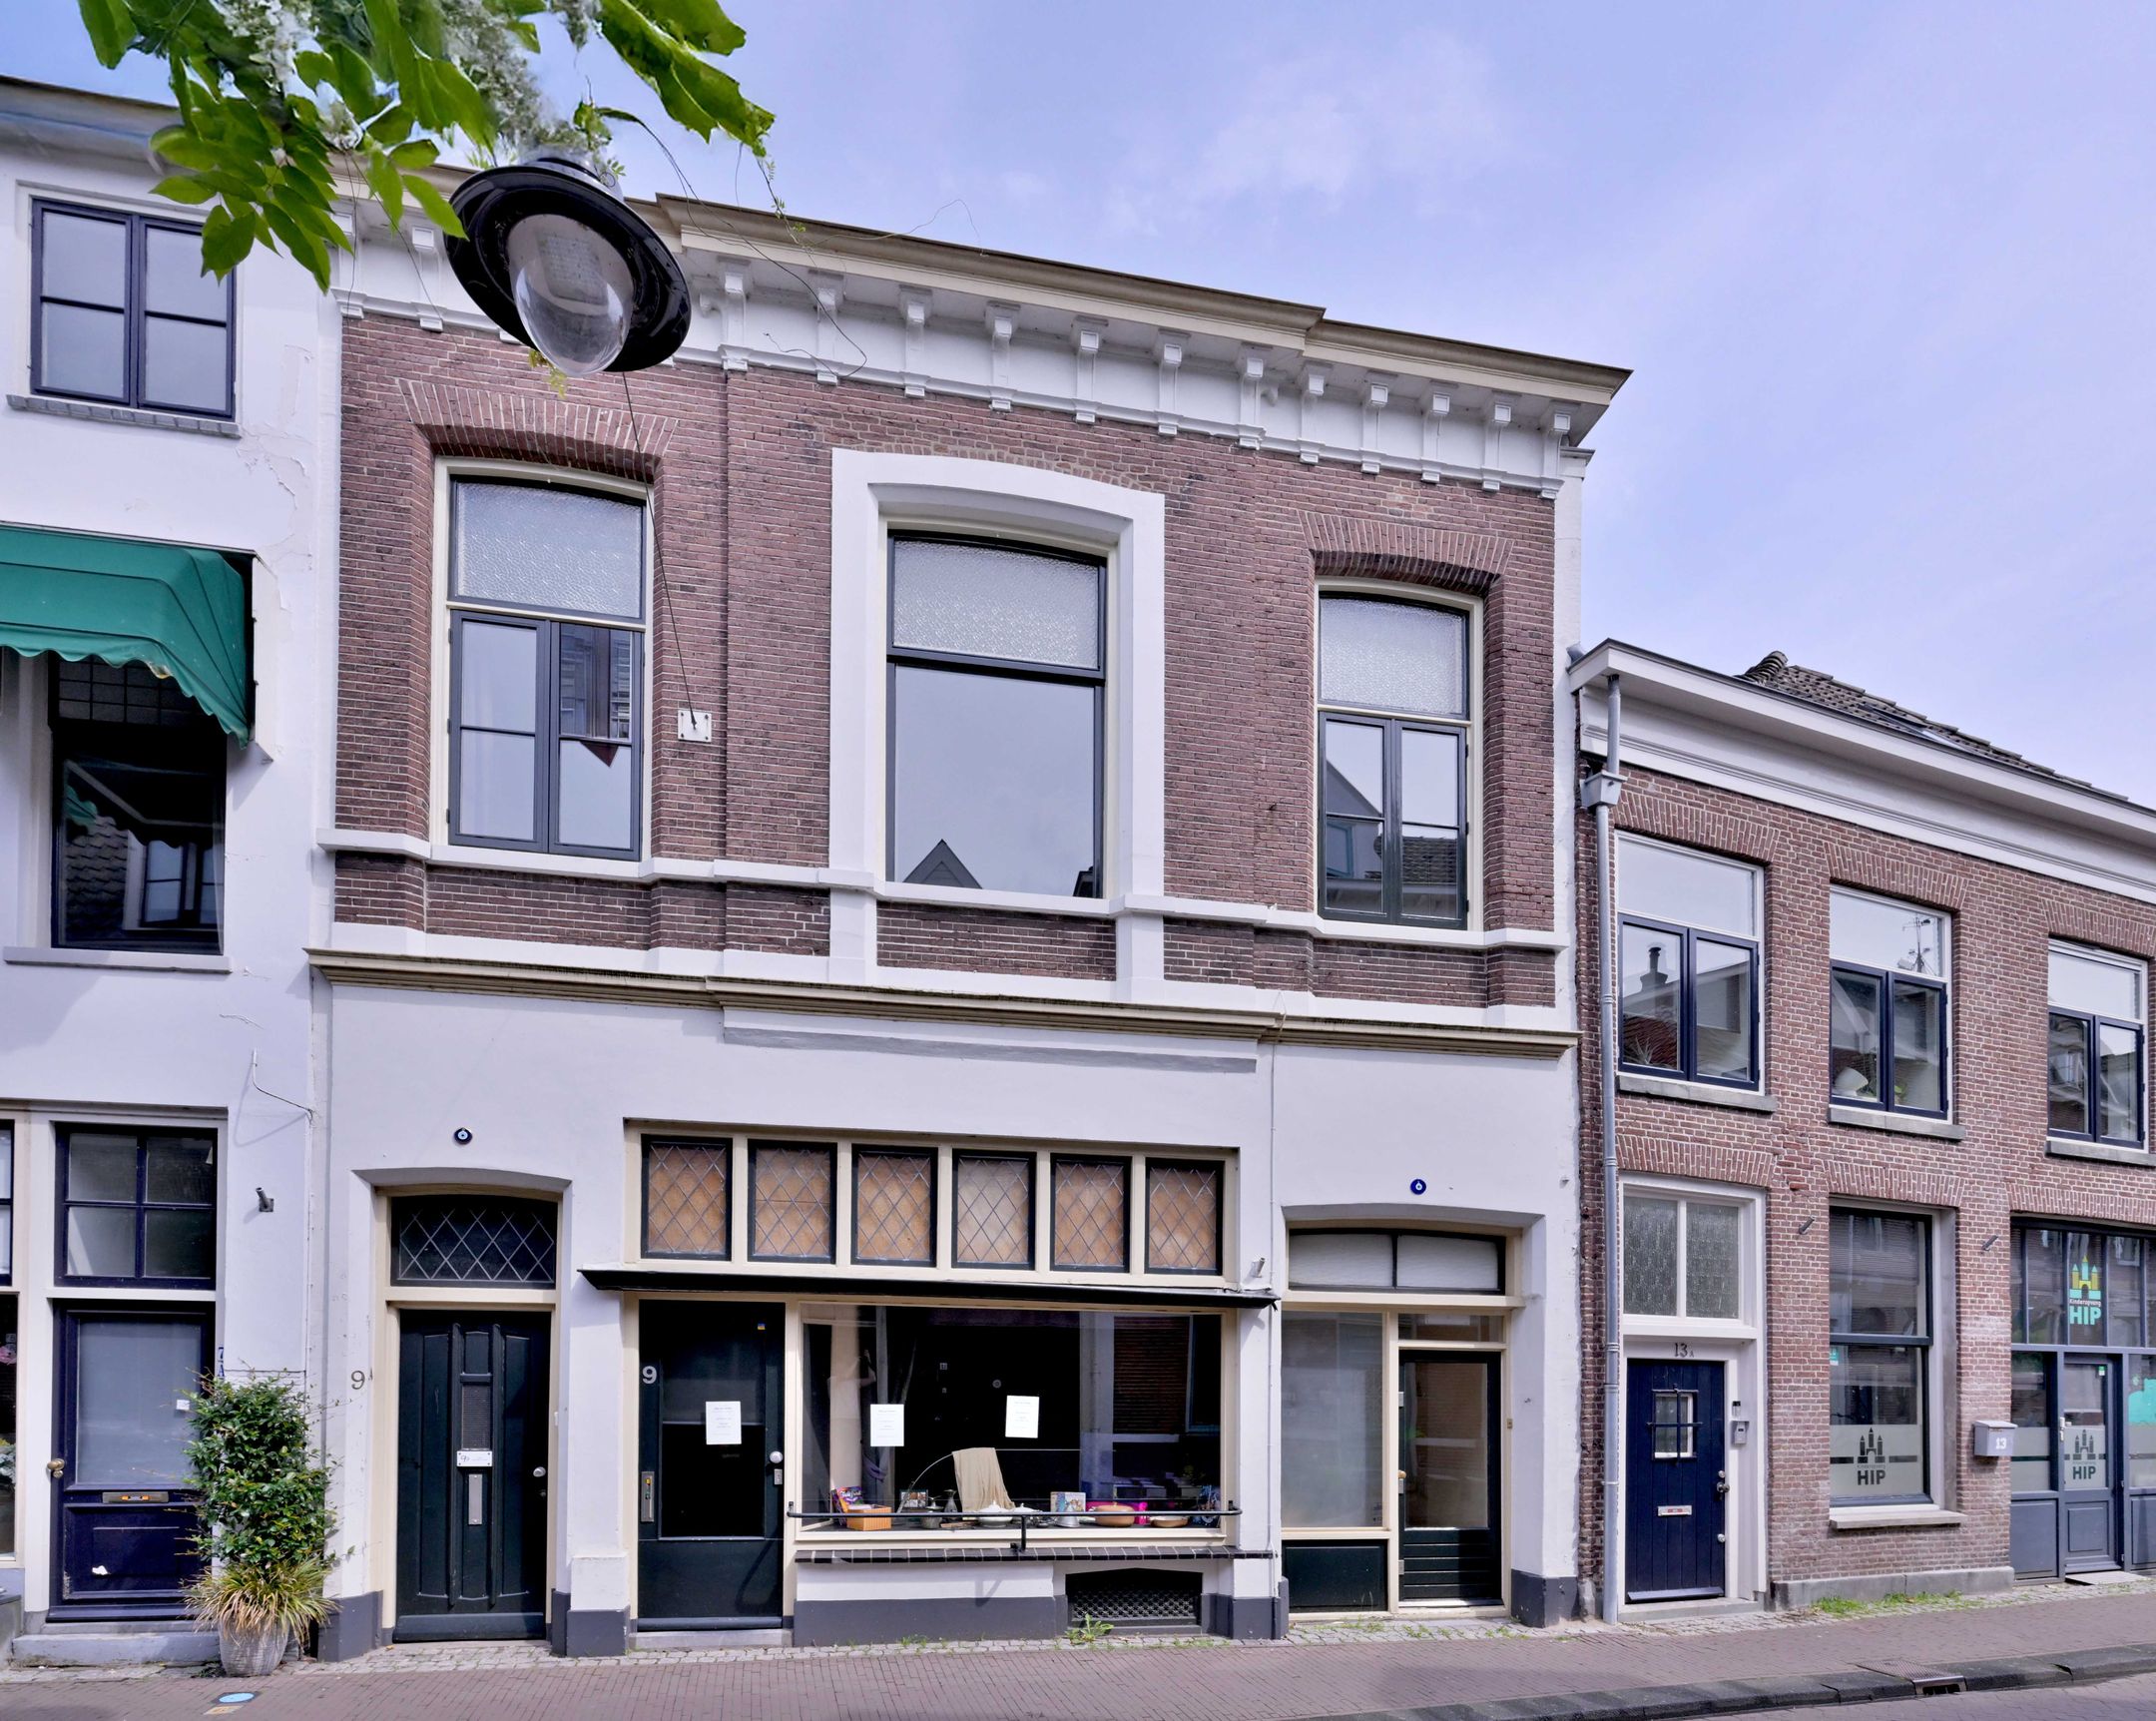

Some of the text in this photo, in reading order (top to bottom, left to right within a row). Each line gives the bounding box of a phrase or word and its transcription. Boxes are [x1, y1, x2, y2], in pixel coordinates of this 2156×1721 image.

[2069, 1306, 2102, 1325] HIP
[642, 1366, 658, 1385] 9
[1995, 1437, 2007, 1449] 13
[1858, 1469, 1886, 1486] HIP
[2072, 1466, 2096, 1480] HIP
